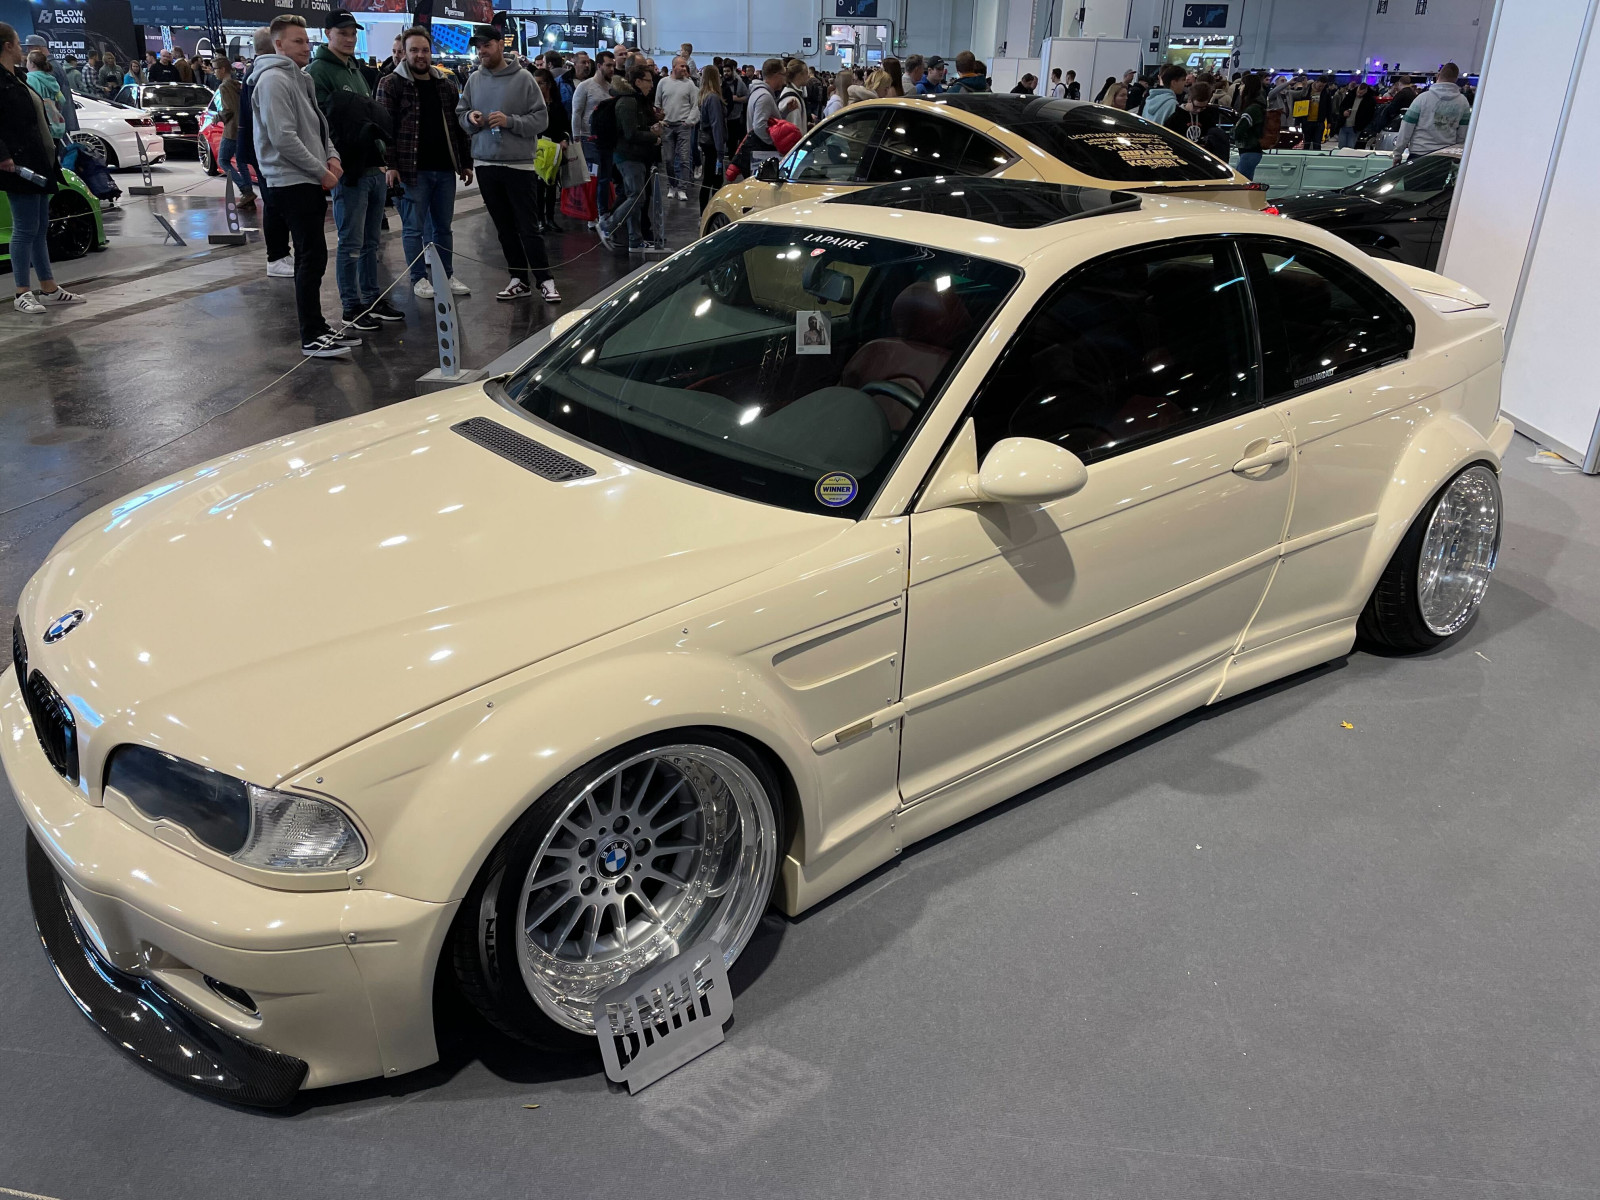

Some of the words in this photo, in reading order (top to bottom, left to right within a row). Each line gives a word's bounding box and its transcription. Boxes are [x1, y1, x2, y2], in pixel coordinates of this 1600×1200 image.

[54, 9, 83, 17] FLOW
[1186, 5, 1193, 17] 6
[55, 16, 87, 24] DOWN
[48, 41, 85, 49] FOLLOW
[803, 233, 869, 250] LAPAIRE
[600, 842, 629, 859] BMW
